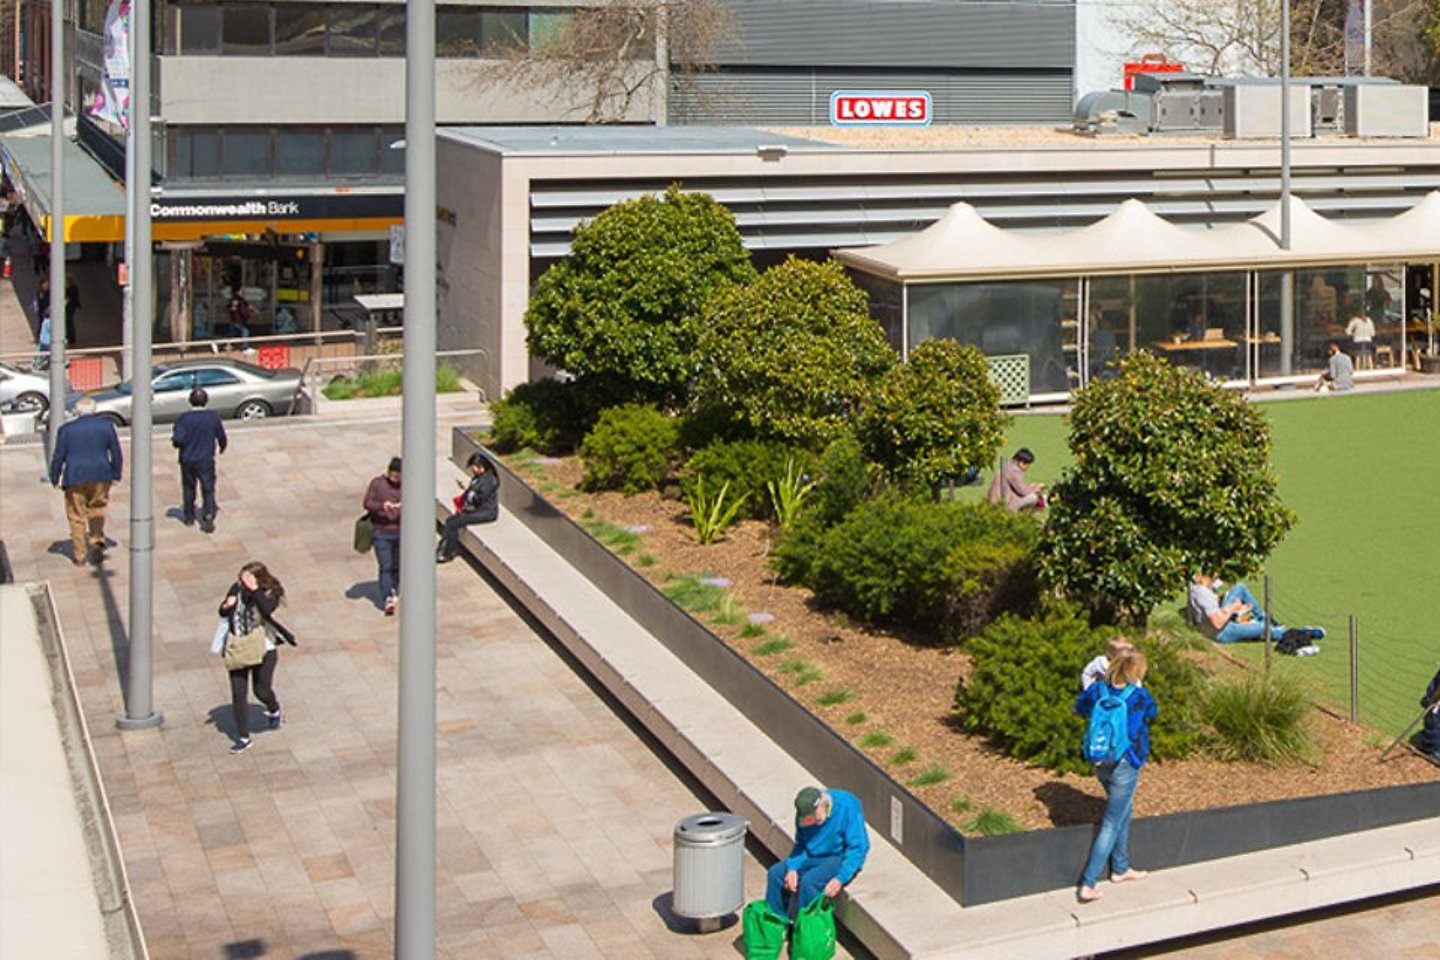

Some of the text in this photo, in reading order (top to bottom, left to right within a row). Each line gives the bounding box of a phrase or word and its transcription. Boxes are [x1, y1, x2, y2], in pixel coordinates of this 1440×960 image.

[841, 100, 924, 118] LOWES
[150, 200, 299, 217] Commonwealth Bank
